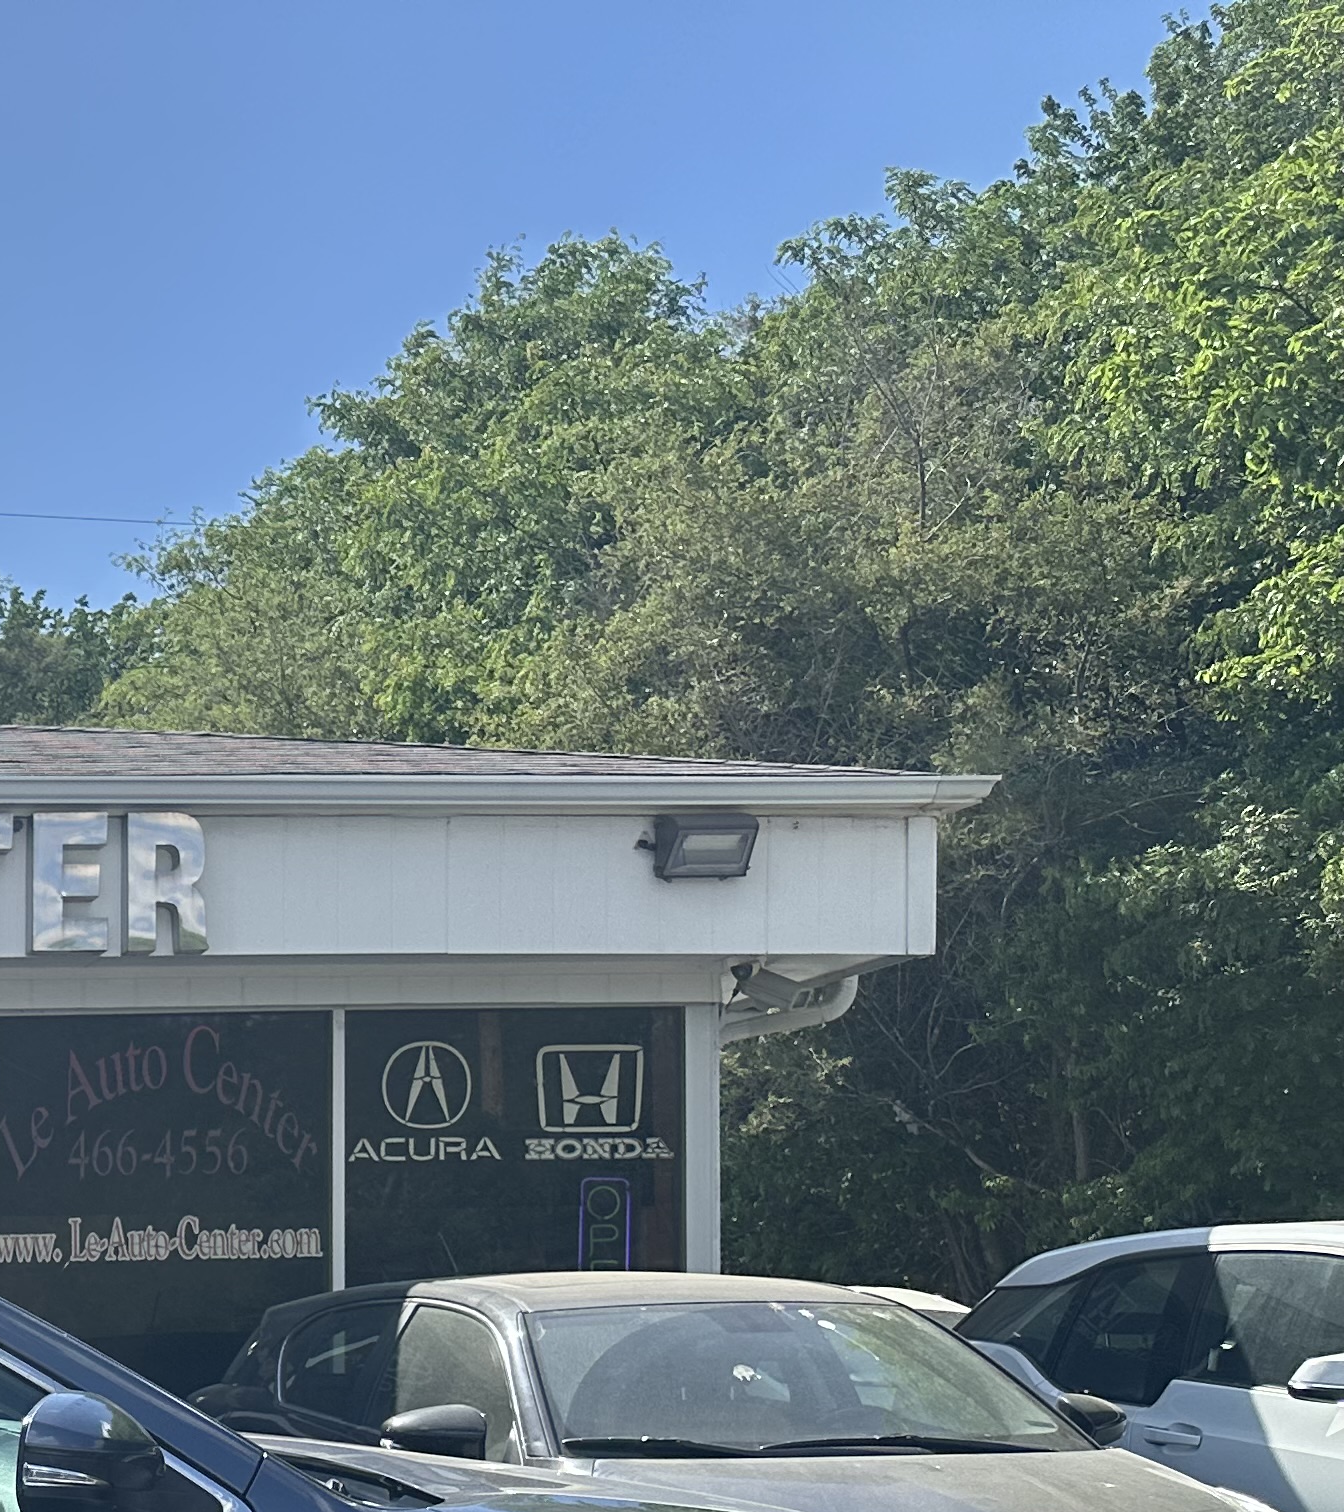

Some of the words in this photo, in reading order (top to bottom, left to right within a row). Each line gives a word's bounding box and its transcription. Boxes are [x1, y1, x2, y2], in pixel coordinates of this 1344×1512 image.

[65, 1040, 168, 1125] Auto
[183, 1025, 319, 1172] Center
[67, 1127, 249, 1180] 466-4556
[348, 1136, 502, 1162] ACURA
[524, 1137, 675, 1160] HONDA
